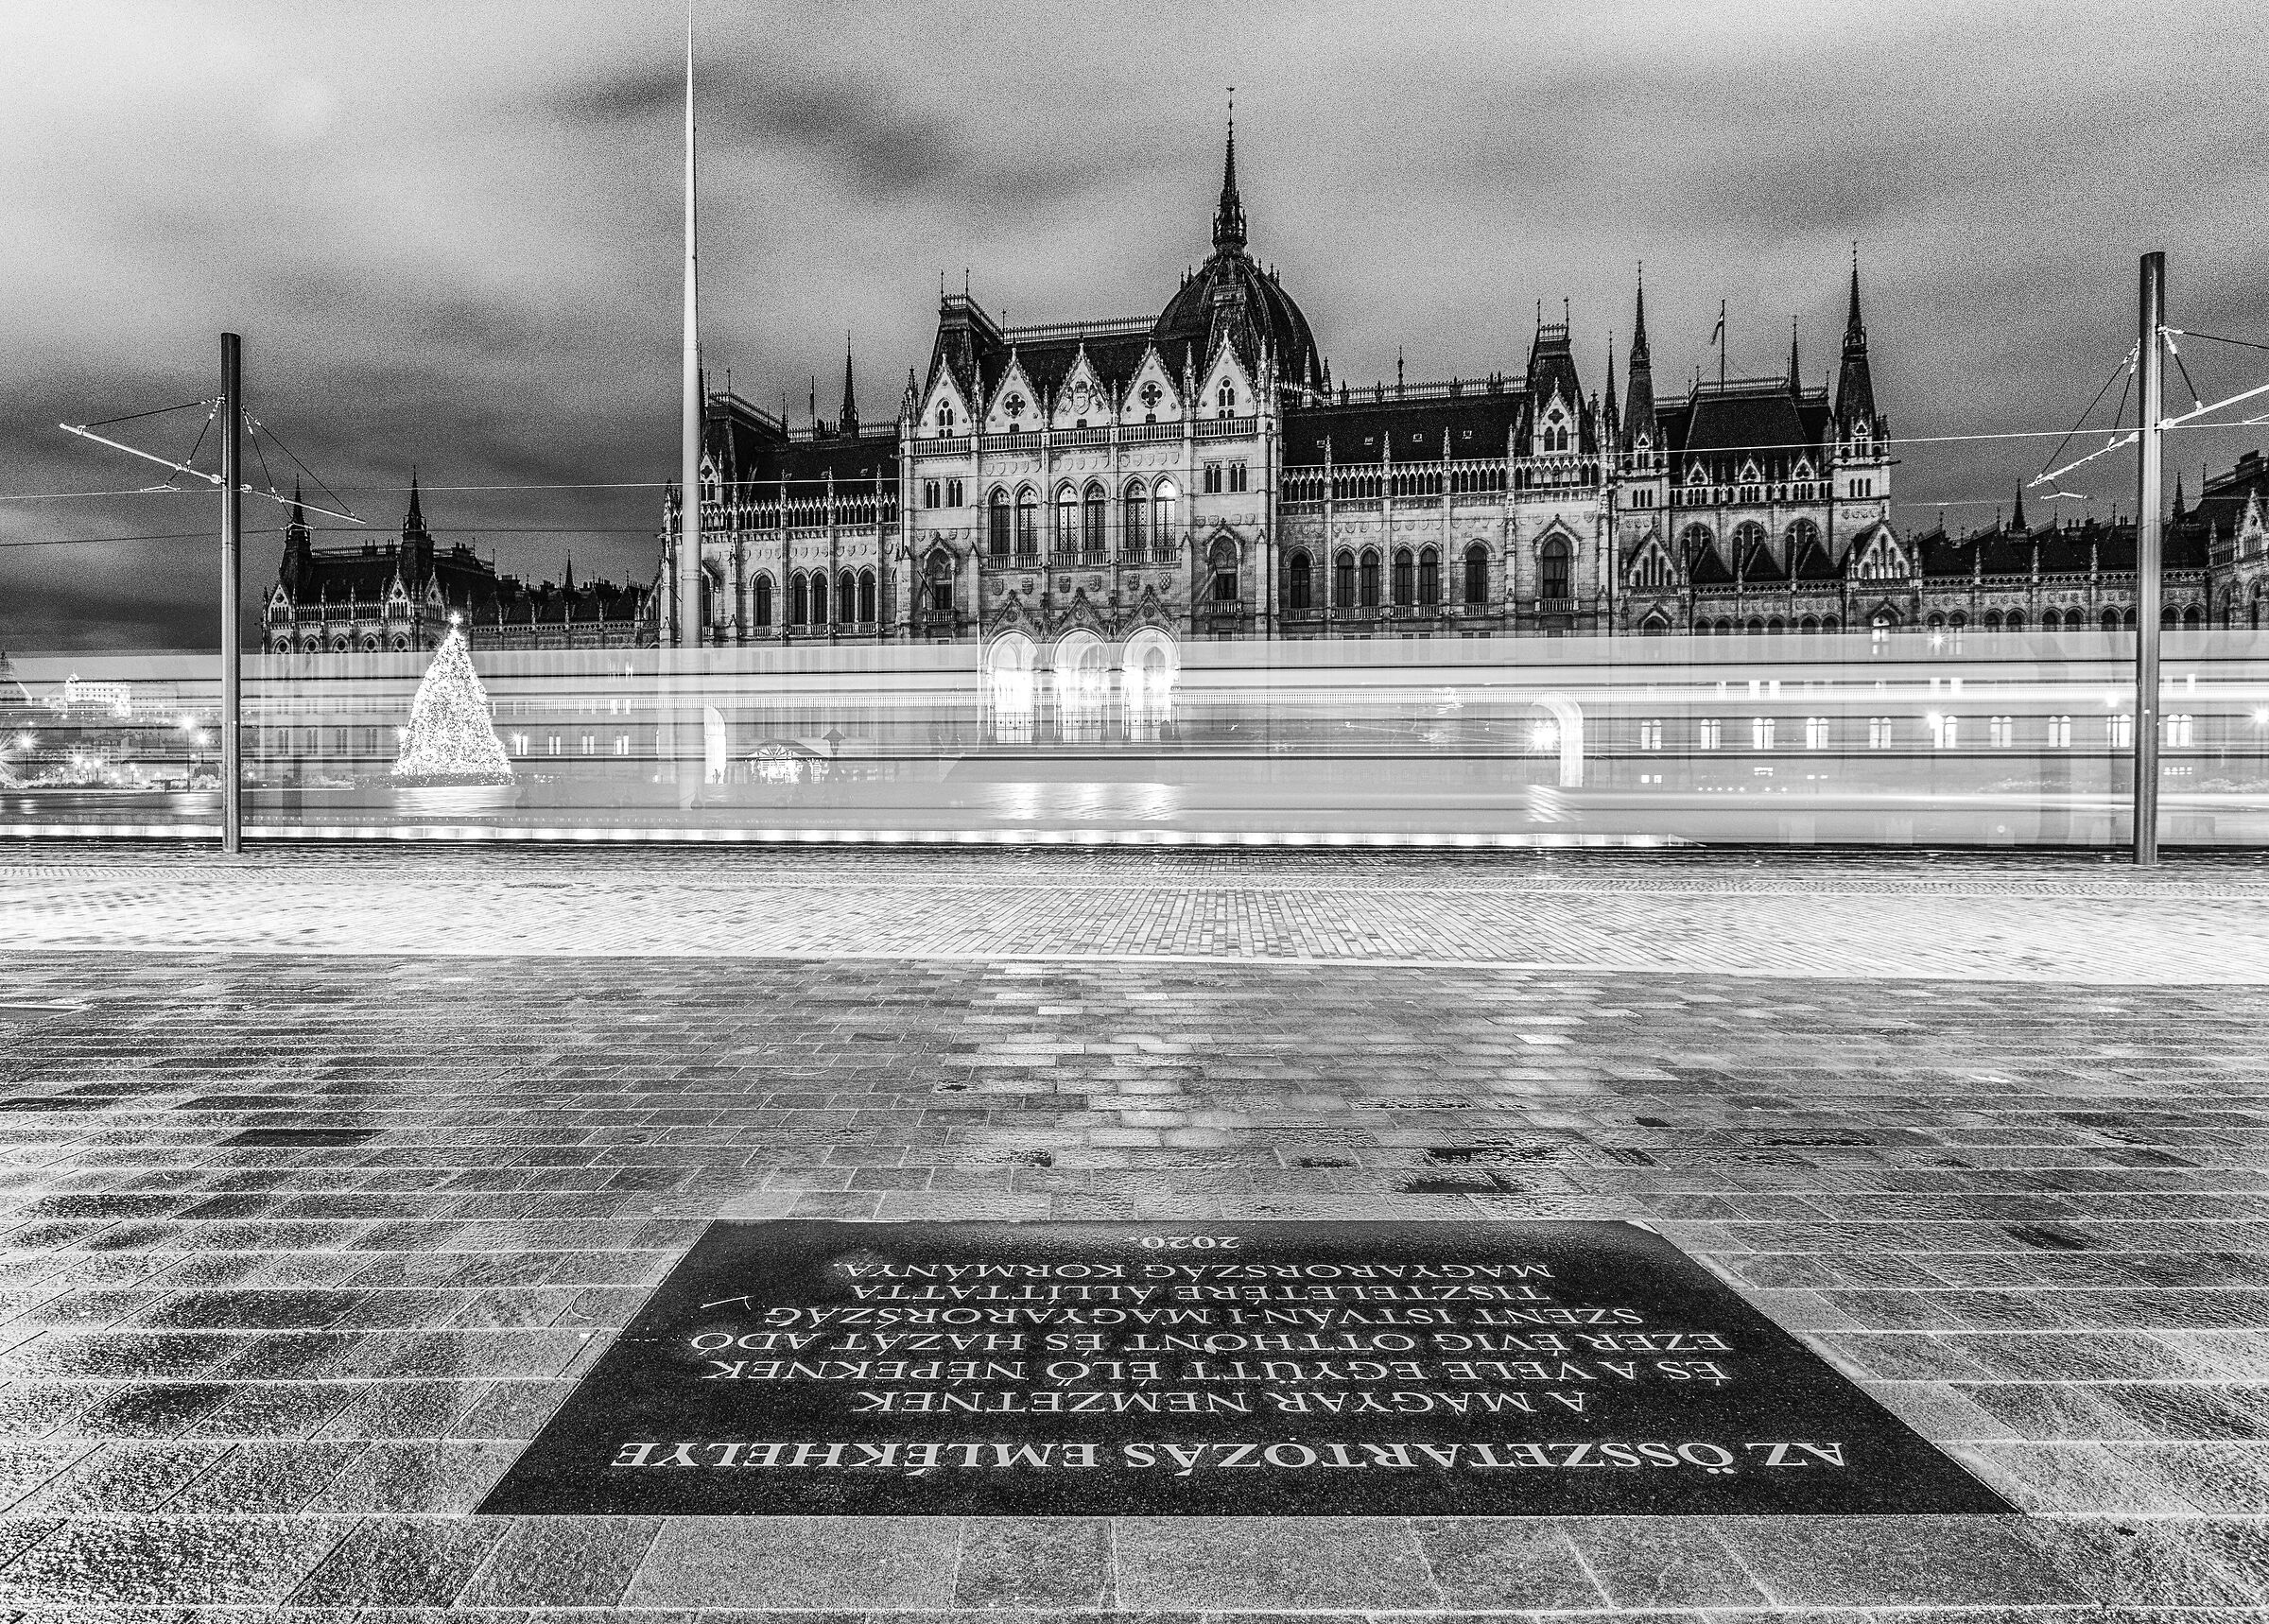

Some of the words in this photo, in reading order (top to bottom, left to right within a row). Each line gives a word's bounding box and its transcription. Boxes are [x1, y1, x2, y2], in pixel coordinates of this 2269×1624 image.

[833, 1263, 1129, 1282] KORMÁNYA.
[1142, 1264, 1555, 1282] MAGYARORSZÁG
[850, 1285, 1159, 1305] ÁLLÍTTATTA
[1175, 1285, 1551, 1304] TISZTELETÉRE
[764, 1307, 1211, 1330] MAGYARORSZÁG
[1231, 1307, 1457, 1329] ISTVÁN-I
[1473, 1307, 1643, 1325] SZENT
[689, 1333, 823, 1356] ADÓ
[833, 1333, 1025, 1356] HAZÁT
[1045, 1333, 1105, 1356] ÉS
[1123, 1333, 1416, 1354] OTTHONT
[1432, 1333, 1568, 1356] ÉVIG
[1577, 1333, 1735, 1352] EZER
[702, 1361, 1029, 1387] NÉPEKNEK
[1045, 1361, 1163, 1387] ÉLŐ
[1181, 1361, 1422, 1384] EGYÜTT
[1446, 1361, 1588, 1381] VELE
[1595, 1361, 1636, 1380] A
[1658, 1361, 1731, 1386] ÉS
[853, 1391, 1253, 1413] NEMZETNEK
[1267, 1391, 1534, 1412] MAGYAR
[1544, 1391, 1585, 1412] A
[610, 1443, 1101, 1476] EMLÉKHELYE
[1122, 1443, 1734, 1475] ÖSSZETARTOZÁS
[1745, 1443, 1845, 1467] AZ
